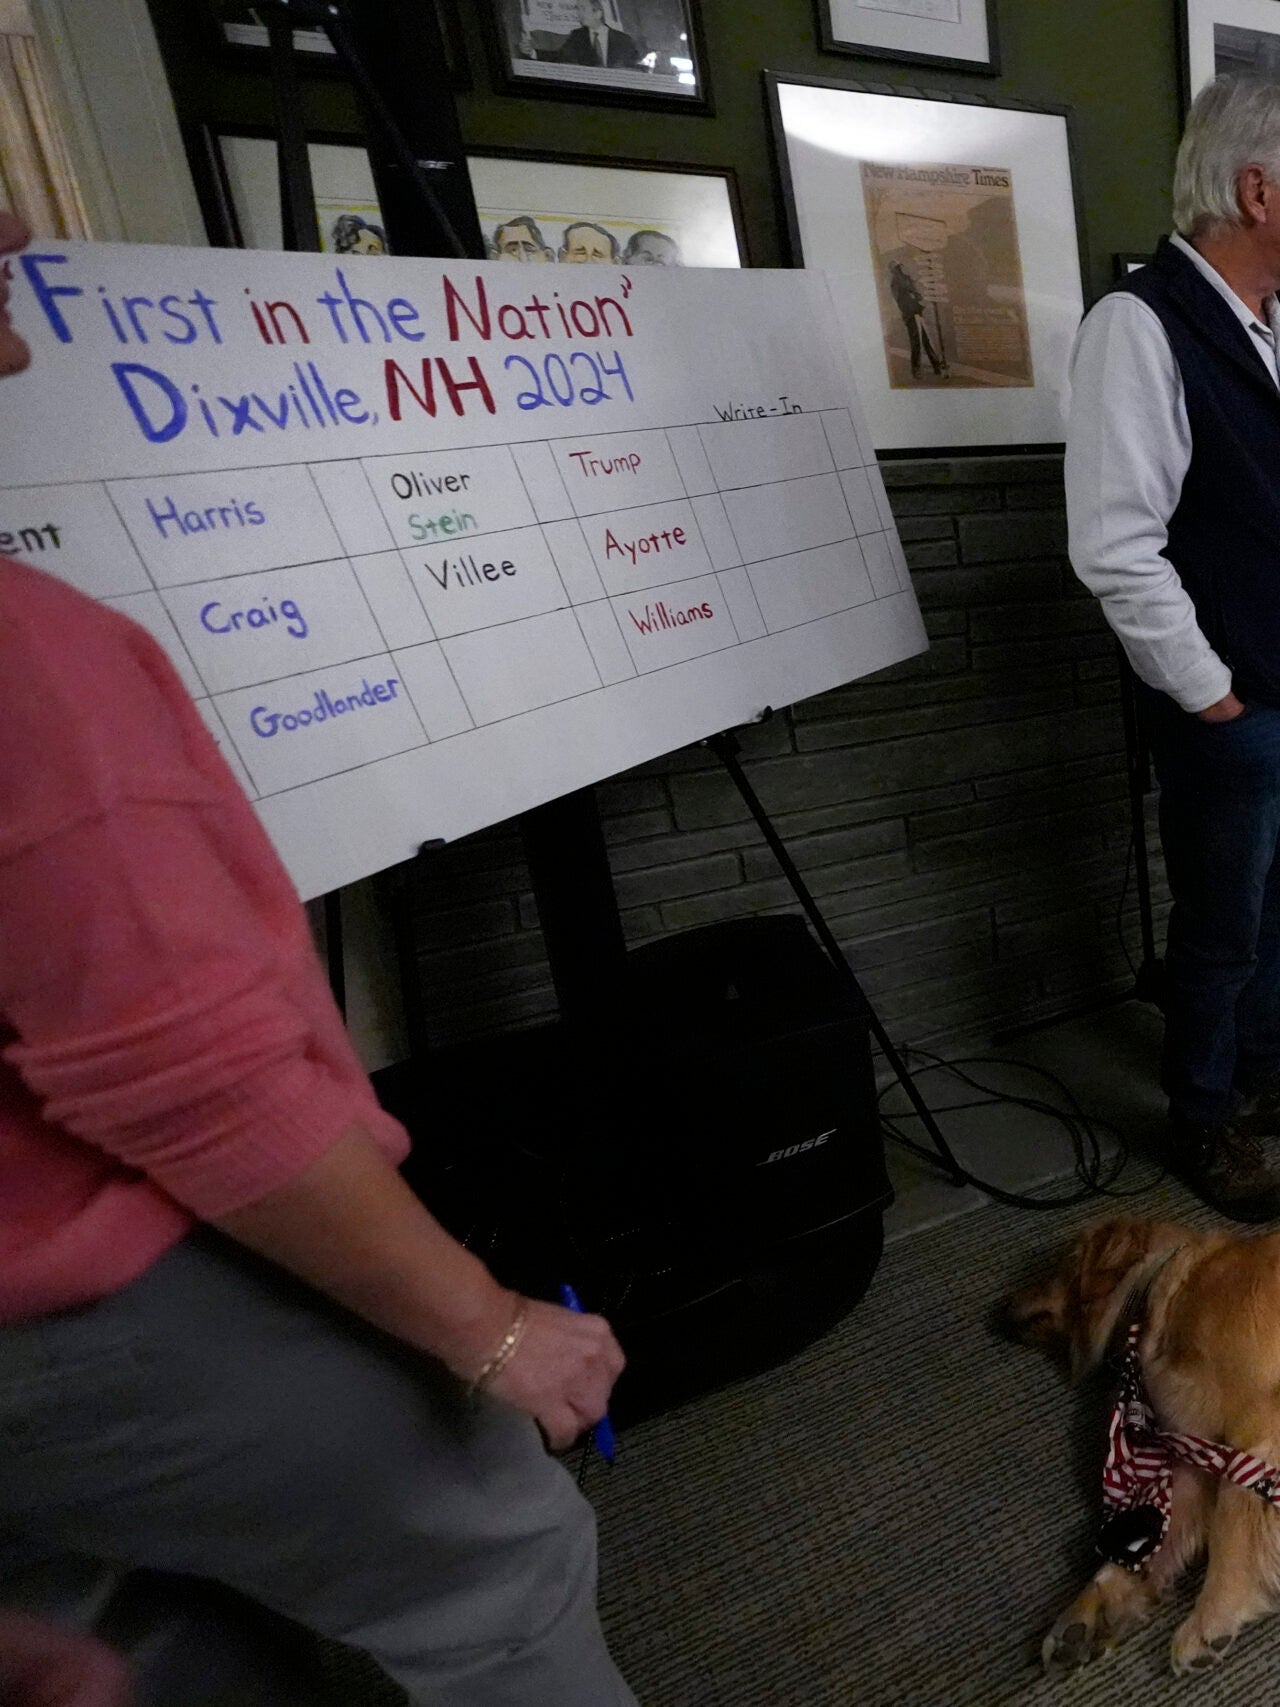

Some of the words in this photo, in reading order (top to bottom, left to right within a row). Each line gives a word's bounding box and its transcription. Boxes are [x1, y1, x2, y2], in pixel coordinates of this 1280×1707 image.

[971, 168, 1010, 188] Times
[244, 286, 311, 345] in
[316, 266, 426, 344] the
[111, 361, 379, 444] Dixville,
[384, 356, 496, 421] NH
[503, 349, 635, 411] 2024
[712, 396, 804, 421] Write-In
[568, 451, 641, 477] Trump
[390, 471, 471, 500] Oliver
[144, 496, 267, 539] Harris
[407, 510, 478, 541] Stein
[603, 524, 688, 567] Ayotte
[424, 556, 517, 591] Villee
[200, 596, 309, 640] Craig
[628, 599, 714, 637] Williams
[249, 677, 399, 739] Goodlander
[760, 1130, 833, 1165] BOSE
